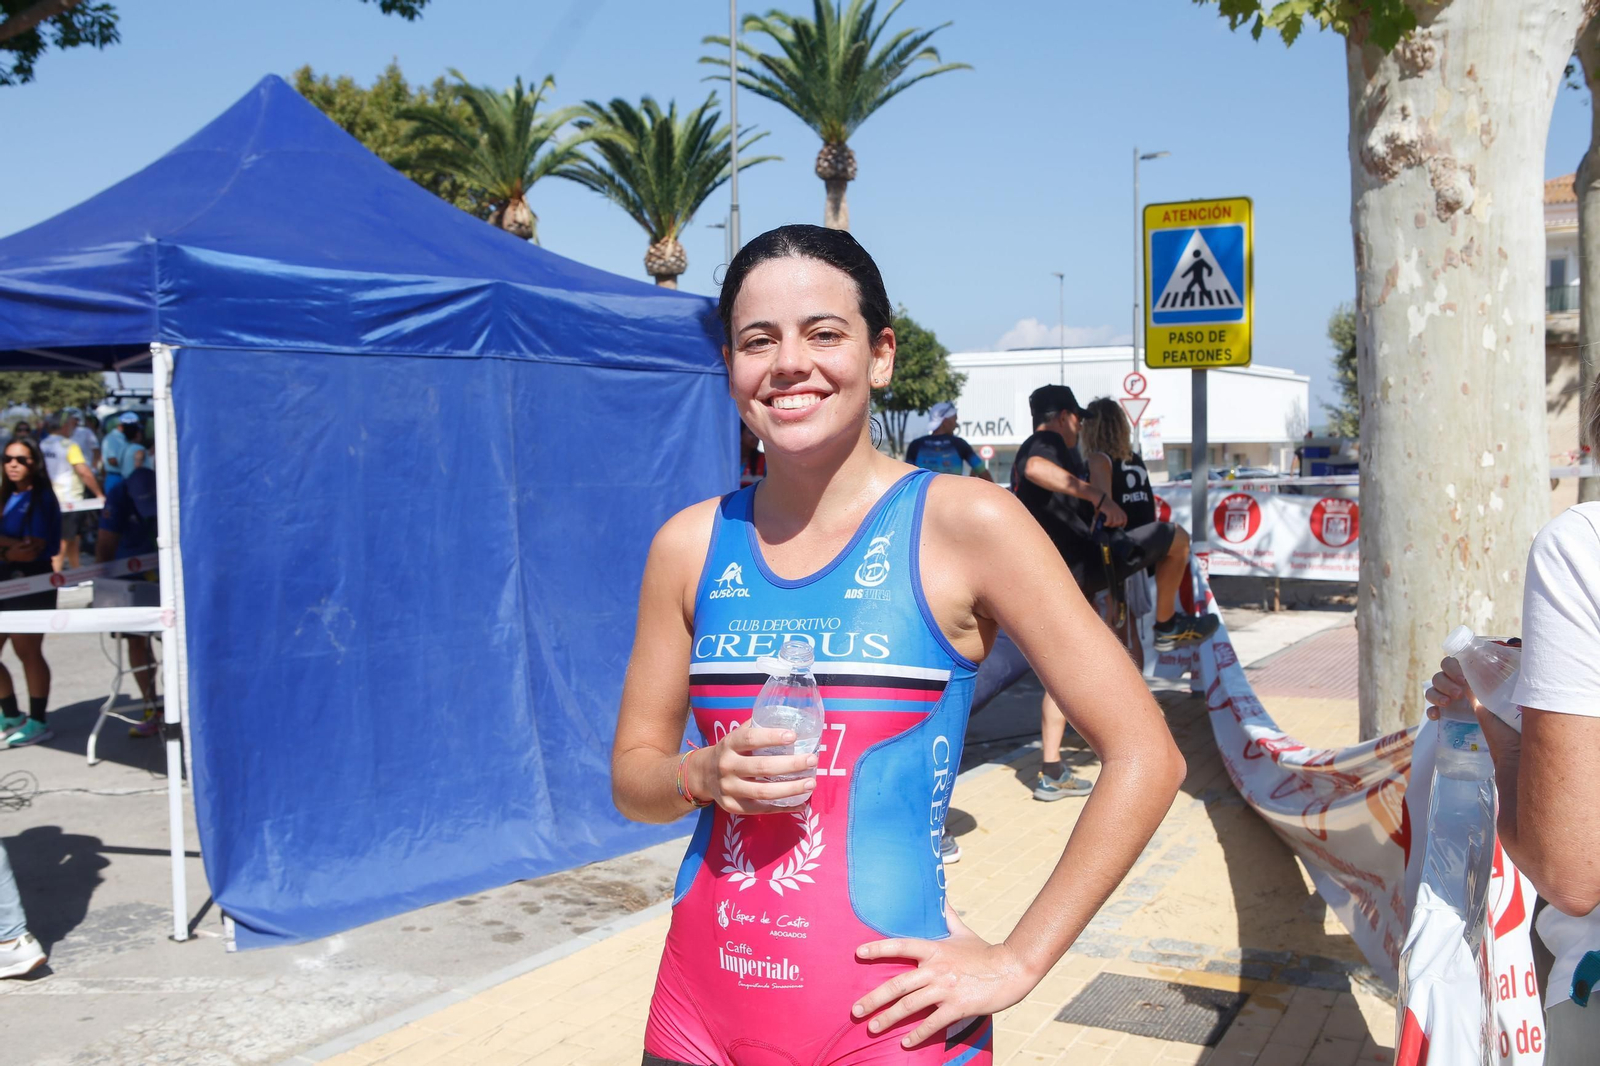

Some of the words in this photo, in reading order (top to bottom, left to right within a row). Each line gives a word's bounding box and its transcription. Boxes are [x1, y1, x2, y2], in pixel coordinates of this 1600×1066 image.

[1162, 204, 1232, 223] ATENCIÓN
[1169, 331, 1204, 344] PASO
[1208, 330, 1226, 343] DE
[1163, 348, 1232, 363] PEATONES
[728, 619, 761, 632] CLUB
[762, 617, 841, 631] DEPORTIVO
[695, 632, 890, 659] CREDUS
[731, 902, 756, 926] López
[760, 911, 771, 924] de
[776, 914, 810, 929] Castro
[769, 930, 807, 939] ABOGADOS
[726, 941, 753, 955] Caffè
[719, 946, 800, 981] Imperiale
[1515, 1020, 1542, 1055] de
